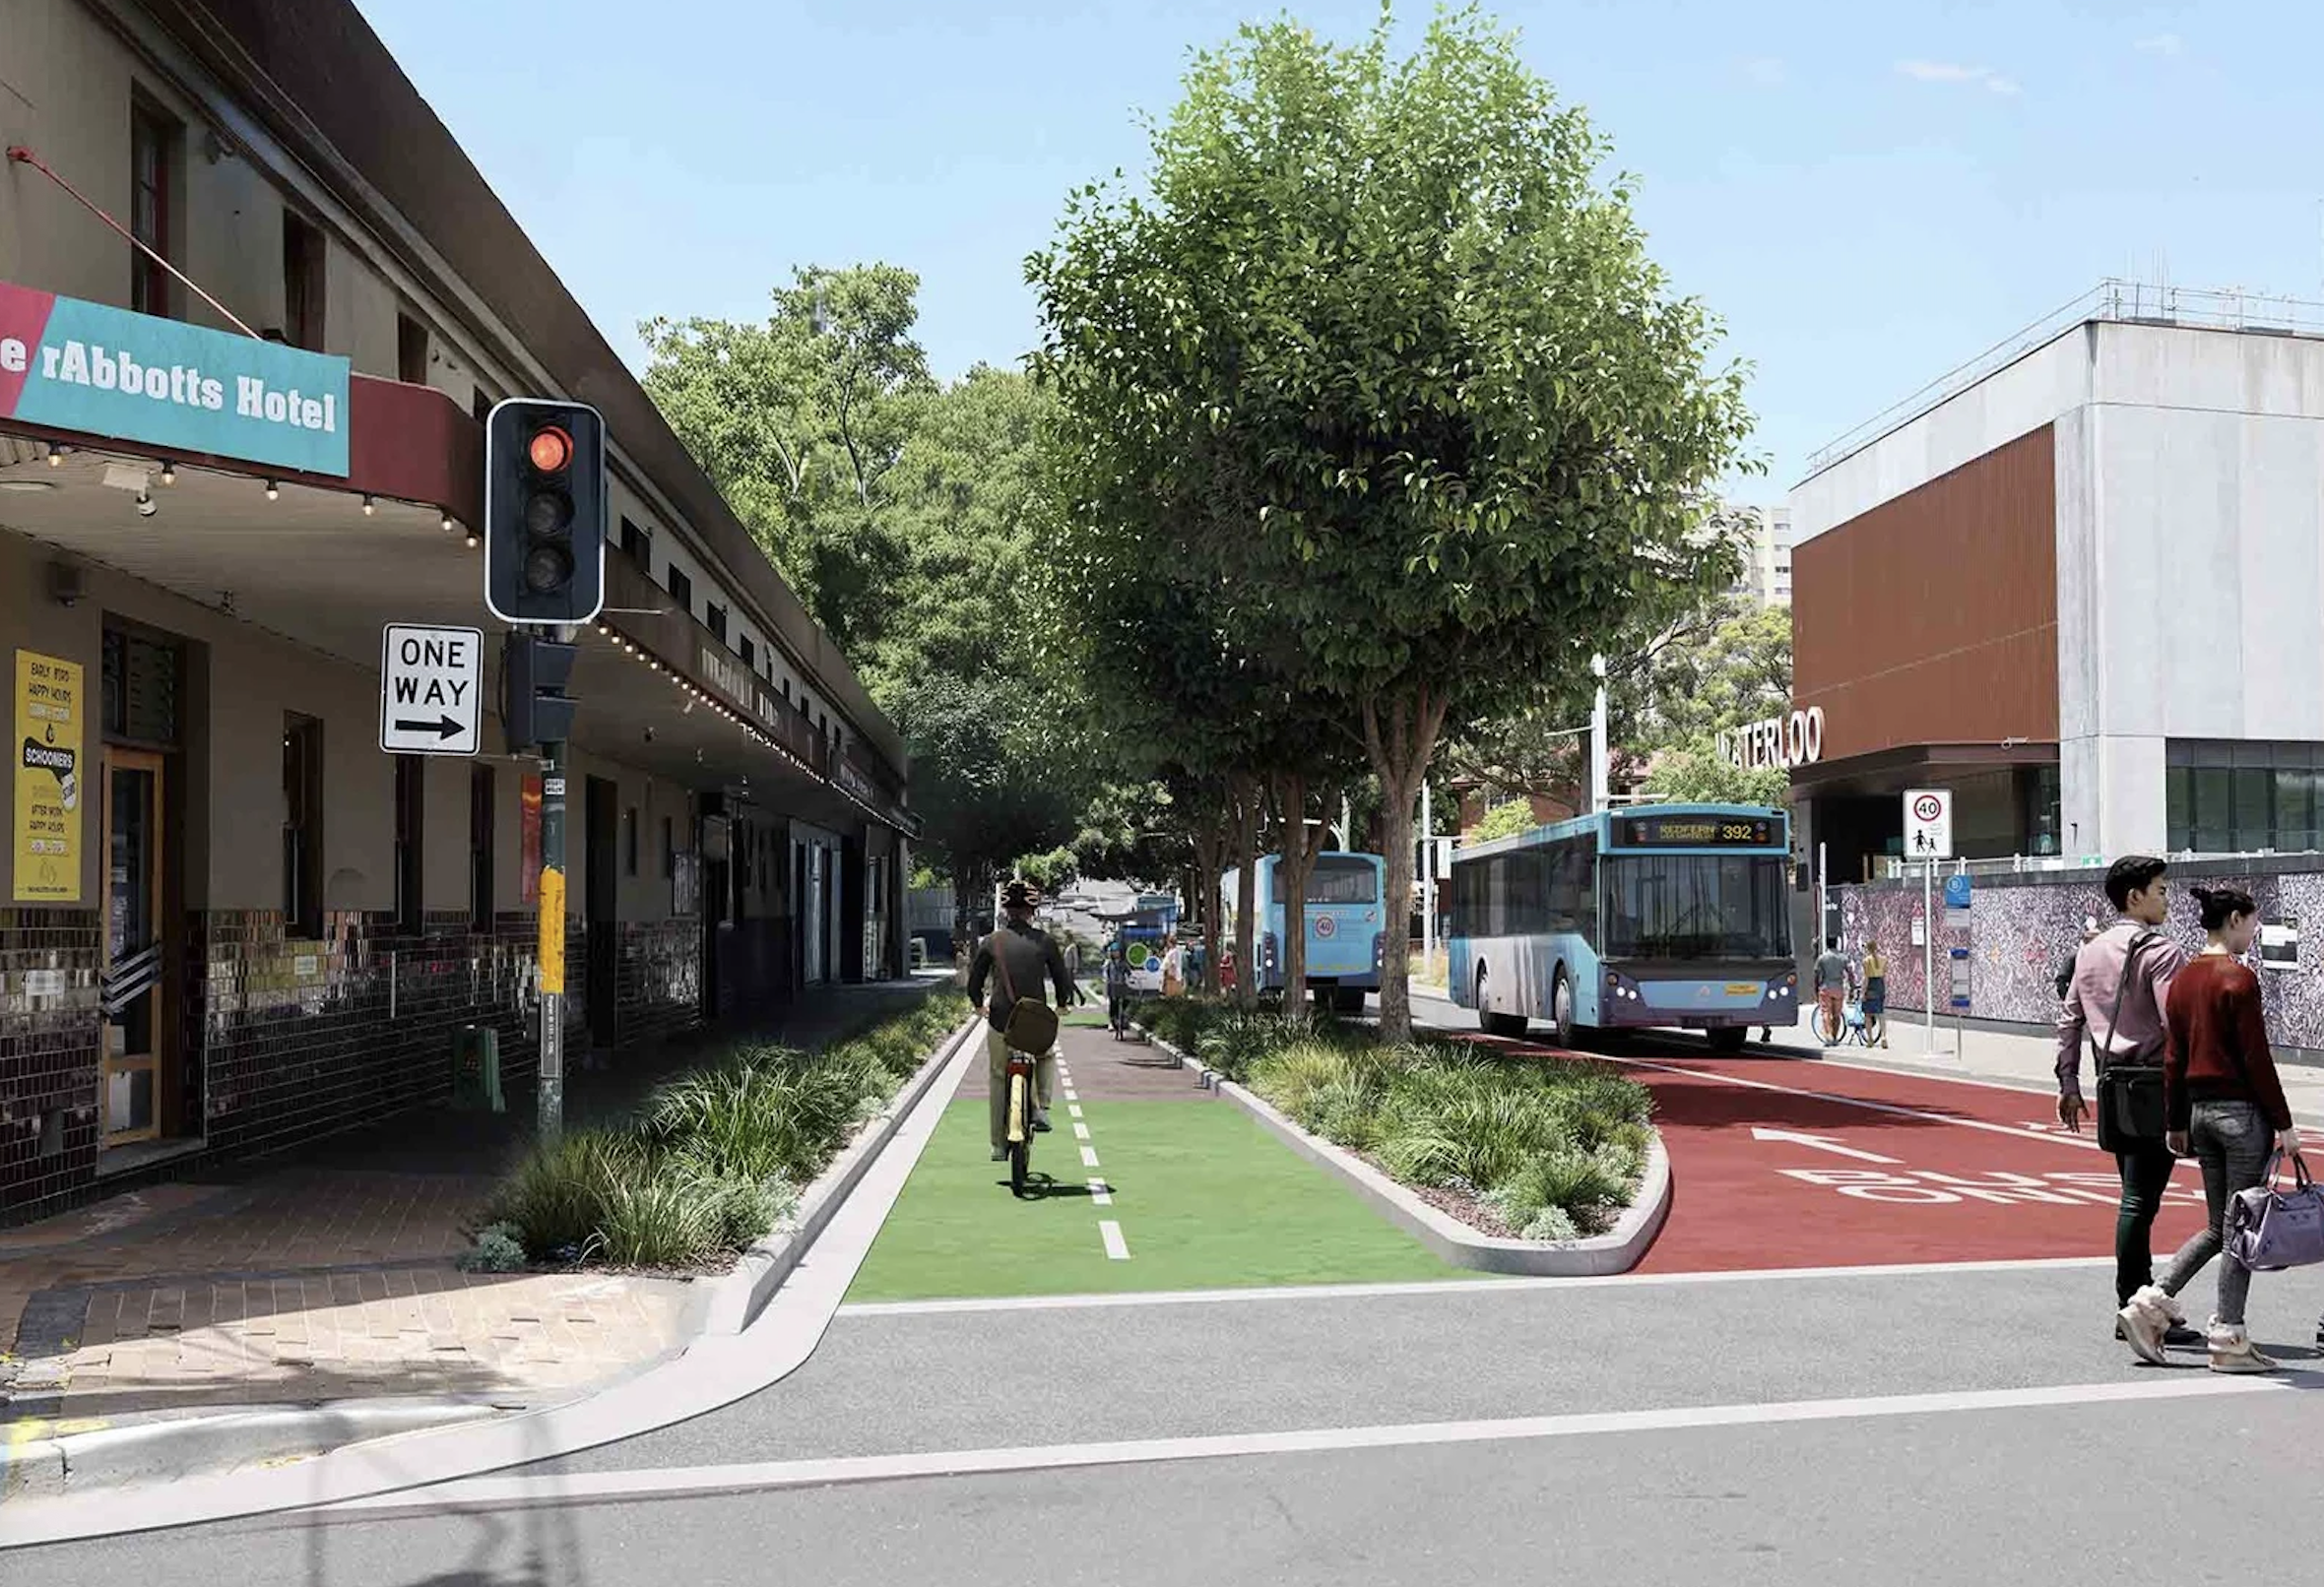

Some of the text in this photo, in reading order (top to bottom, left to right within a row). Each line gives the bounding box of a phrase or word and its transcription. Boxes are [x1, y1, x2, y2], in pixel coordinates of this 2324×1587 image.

[42, 340, 224, 411] rAbbotts
[236, 375, 336, 432] Hotel
[401, 638, 465, 668] ONE
[395, 676, 470, 706] WAY
[26, 746, 73, 768] SCHOONERS
[1918, 802, 1937, 814] 40
[1722, 825, 1752, 839] 392
[1775, 1170, 2182, 1187] BUS
